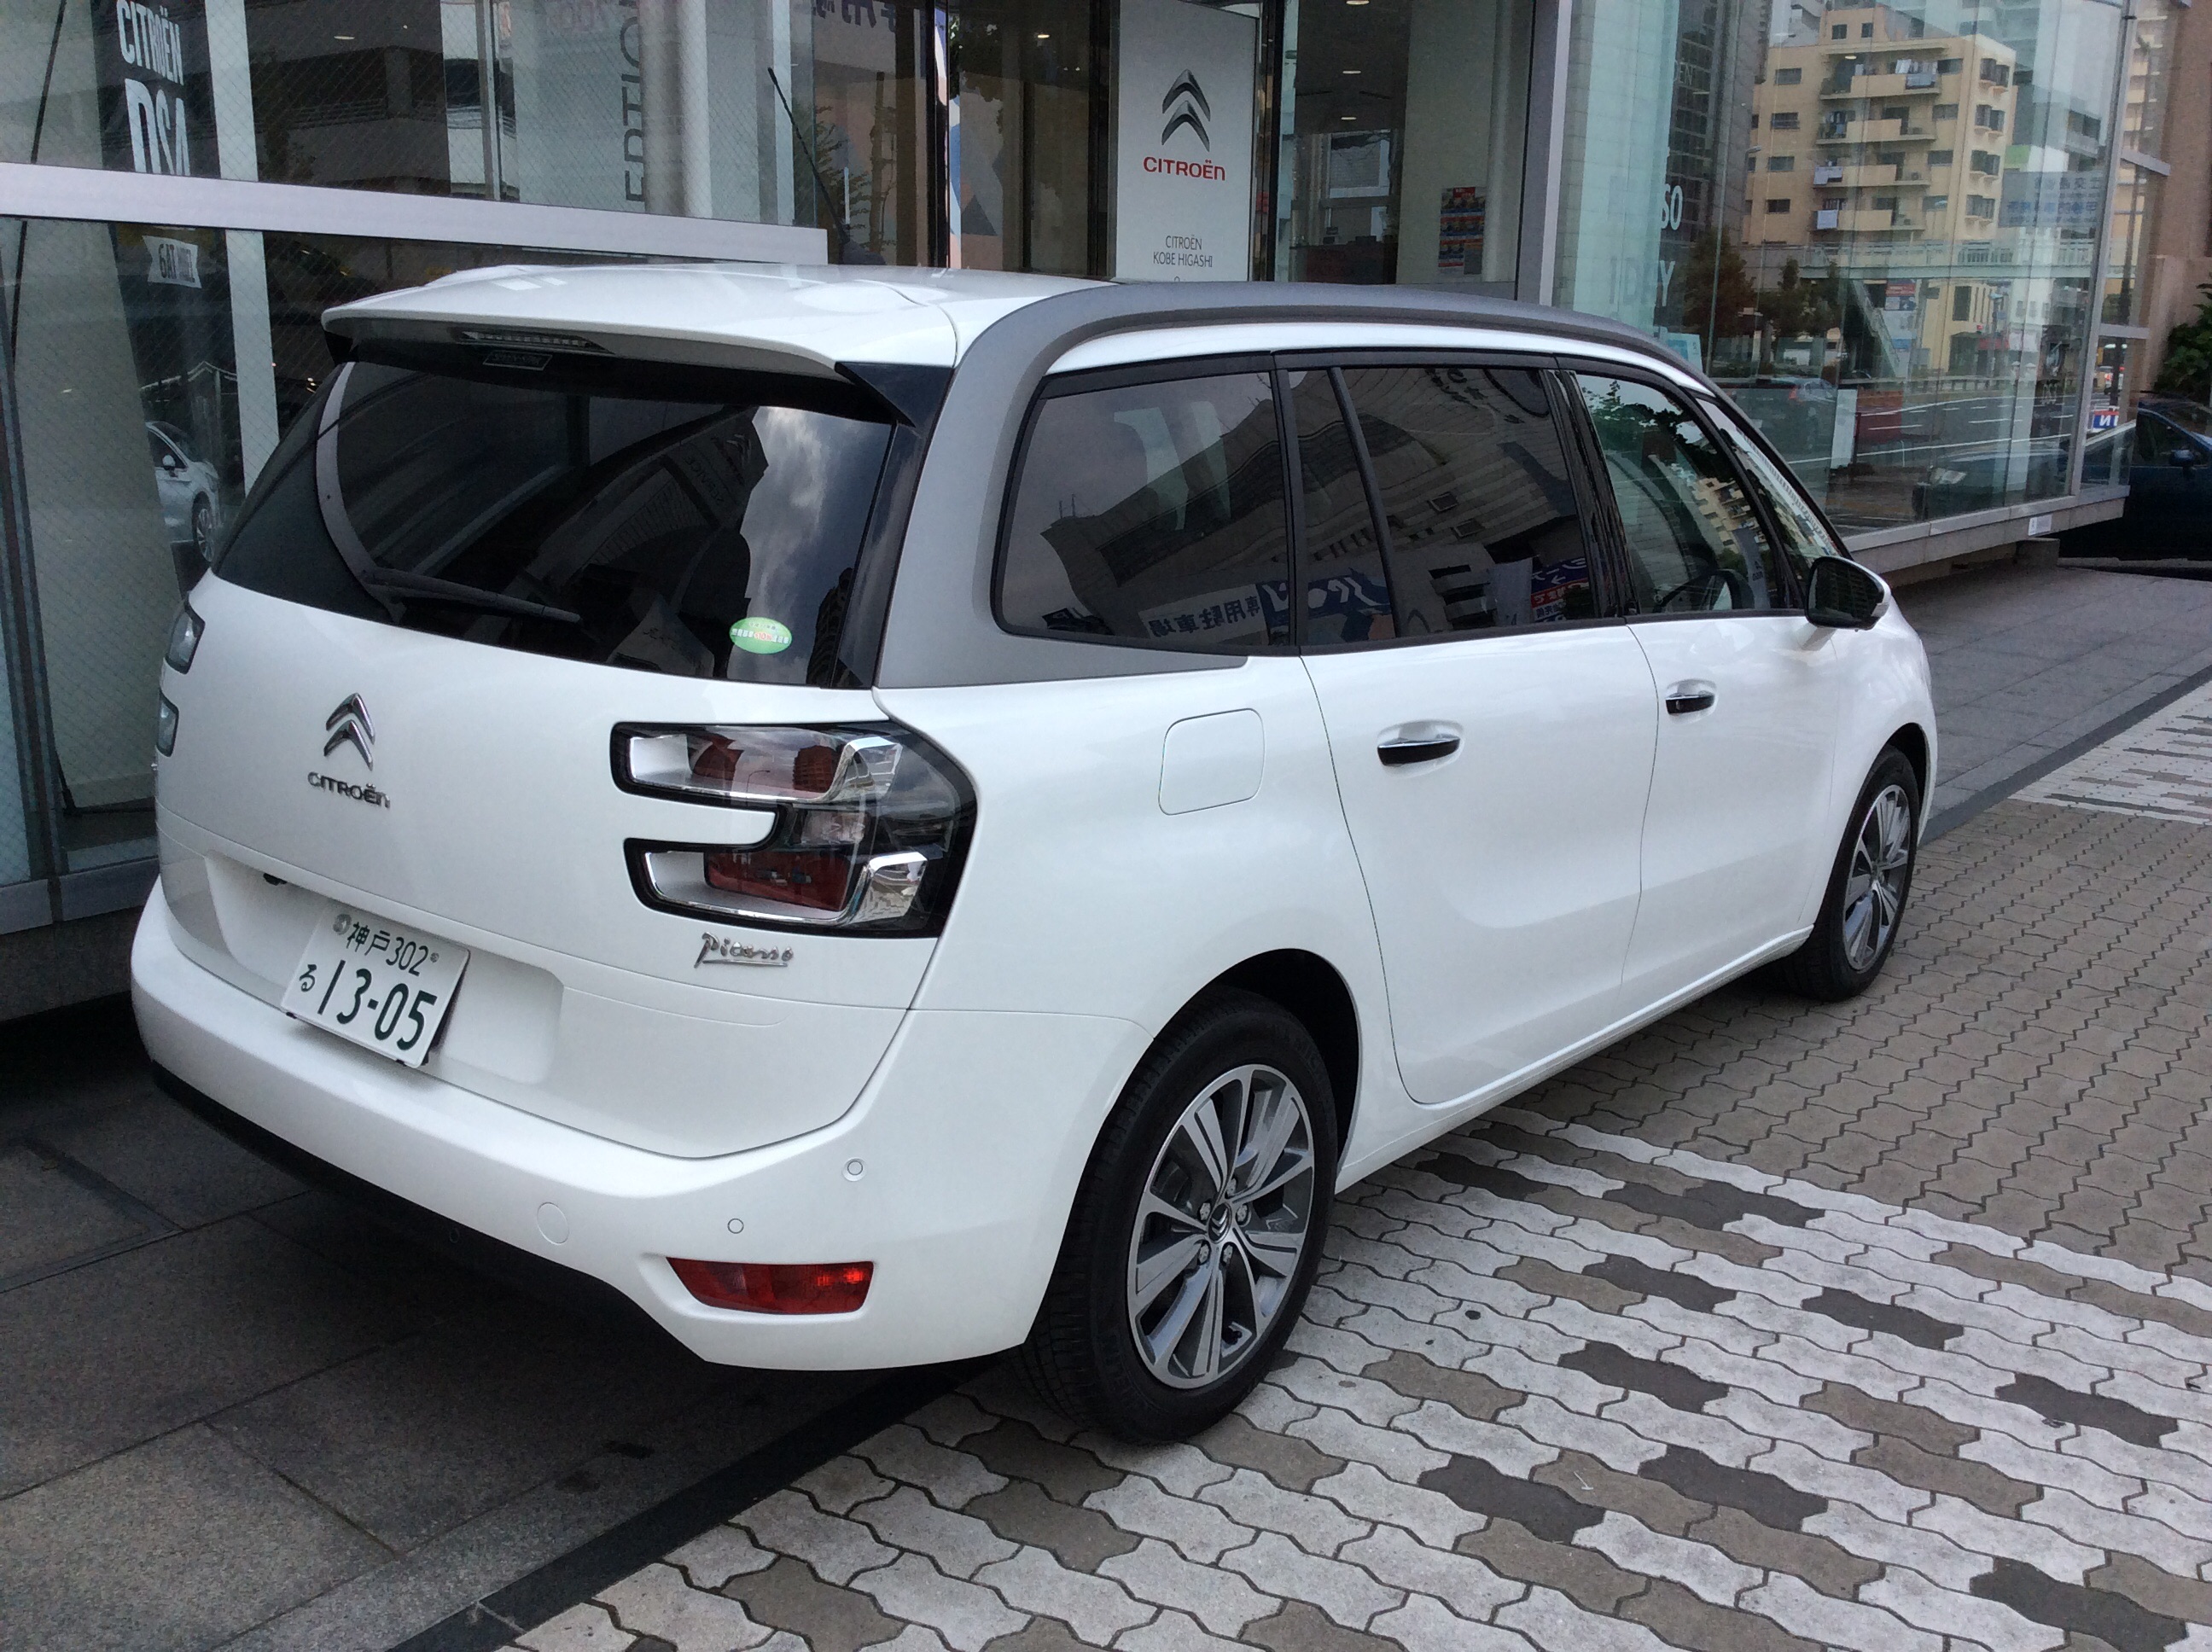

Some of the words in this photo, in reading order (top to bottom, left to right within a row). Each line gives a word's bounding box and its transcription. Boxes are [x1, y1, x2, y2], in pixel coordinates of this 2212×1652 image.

[1166, 234, 1202, 251] CITROËN
[1153, 251, 1176, 265] KOBE
[1178, 253, 1213, 268] HIGASHI
[307, 771, 391, 809] CITROËN
[299, 963, 317, 992] る
[317, 959, 438, 1051] 13-05
